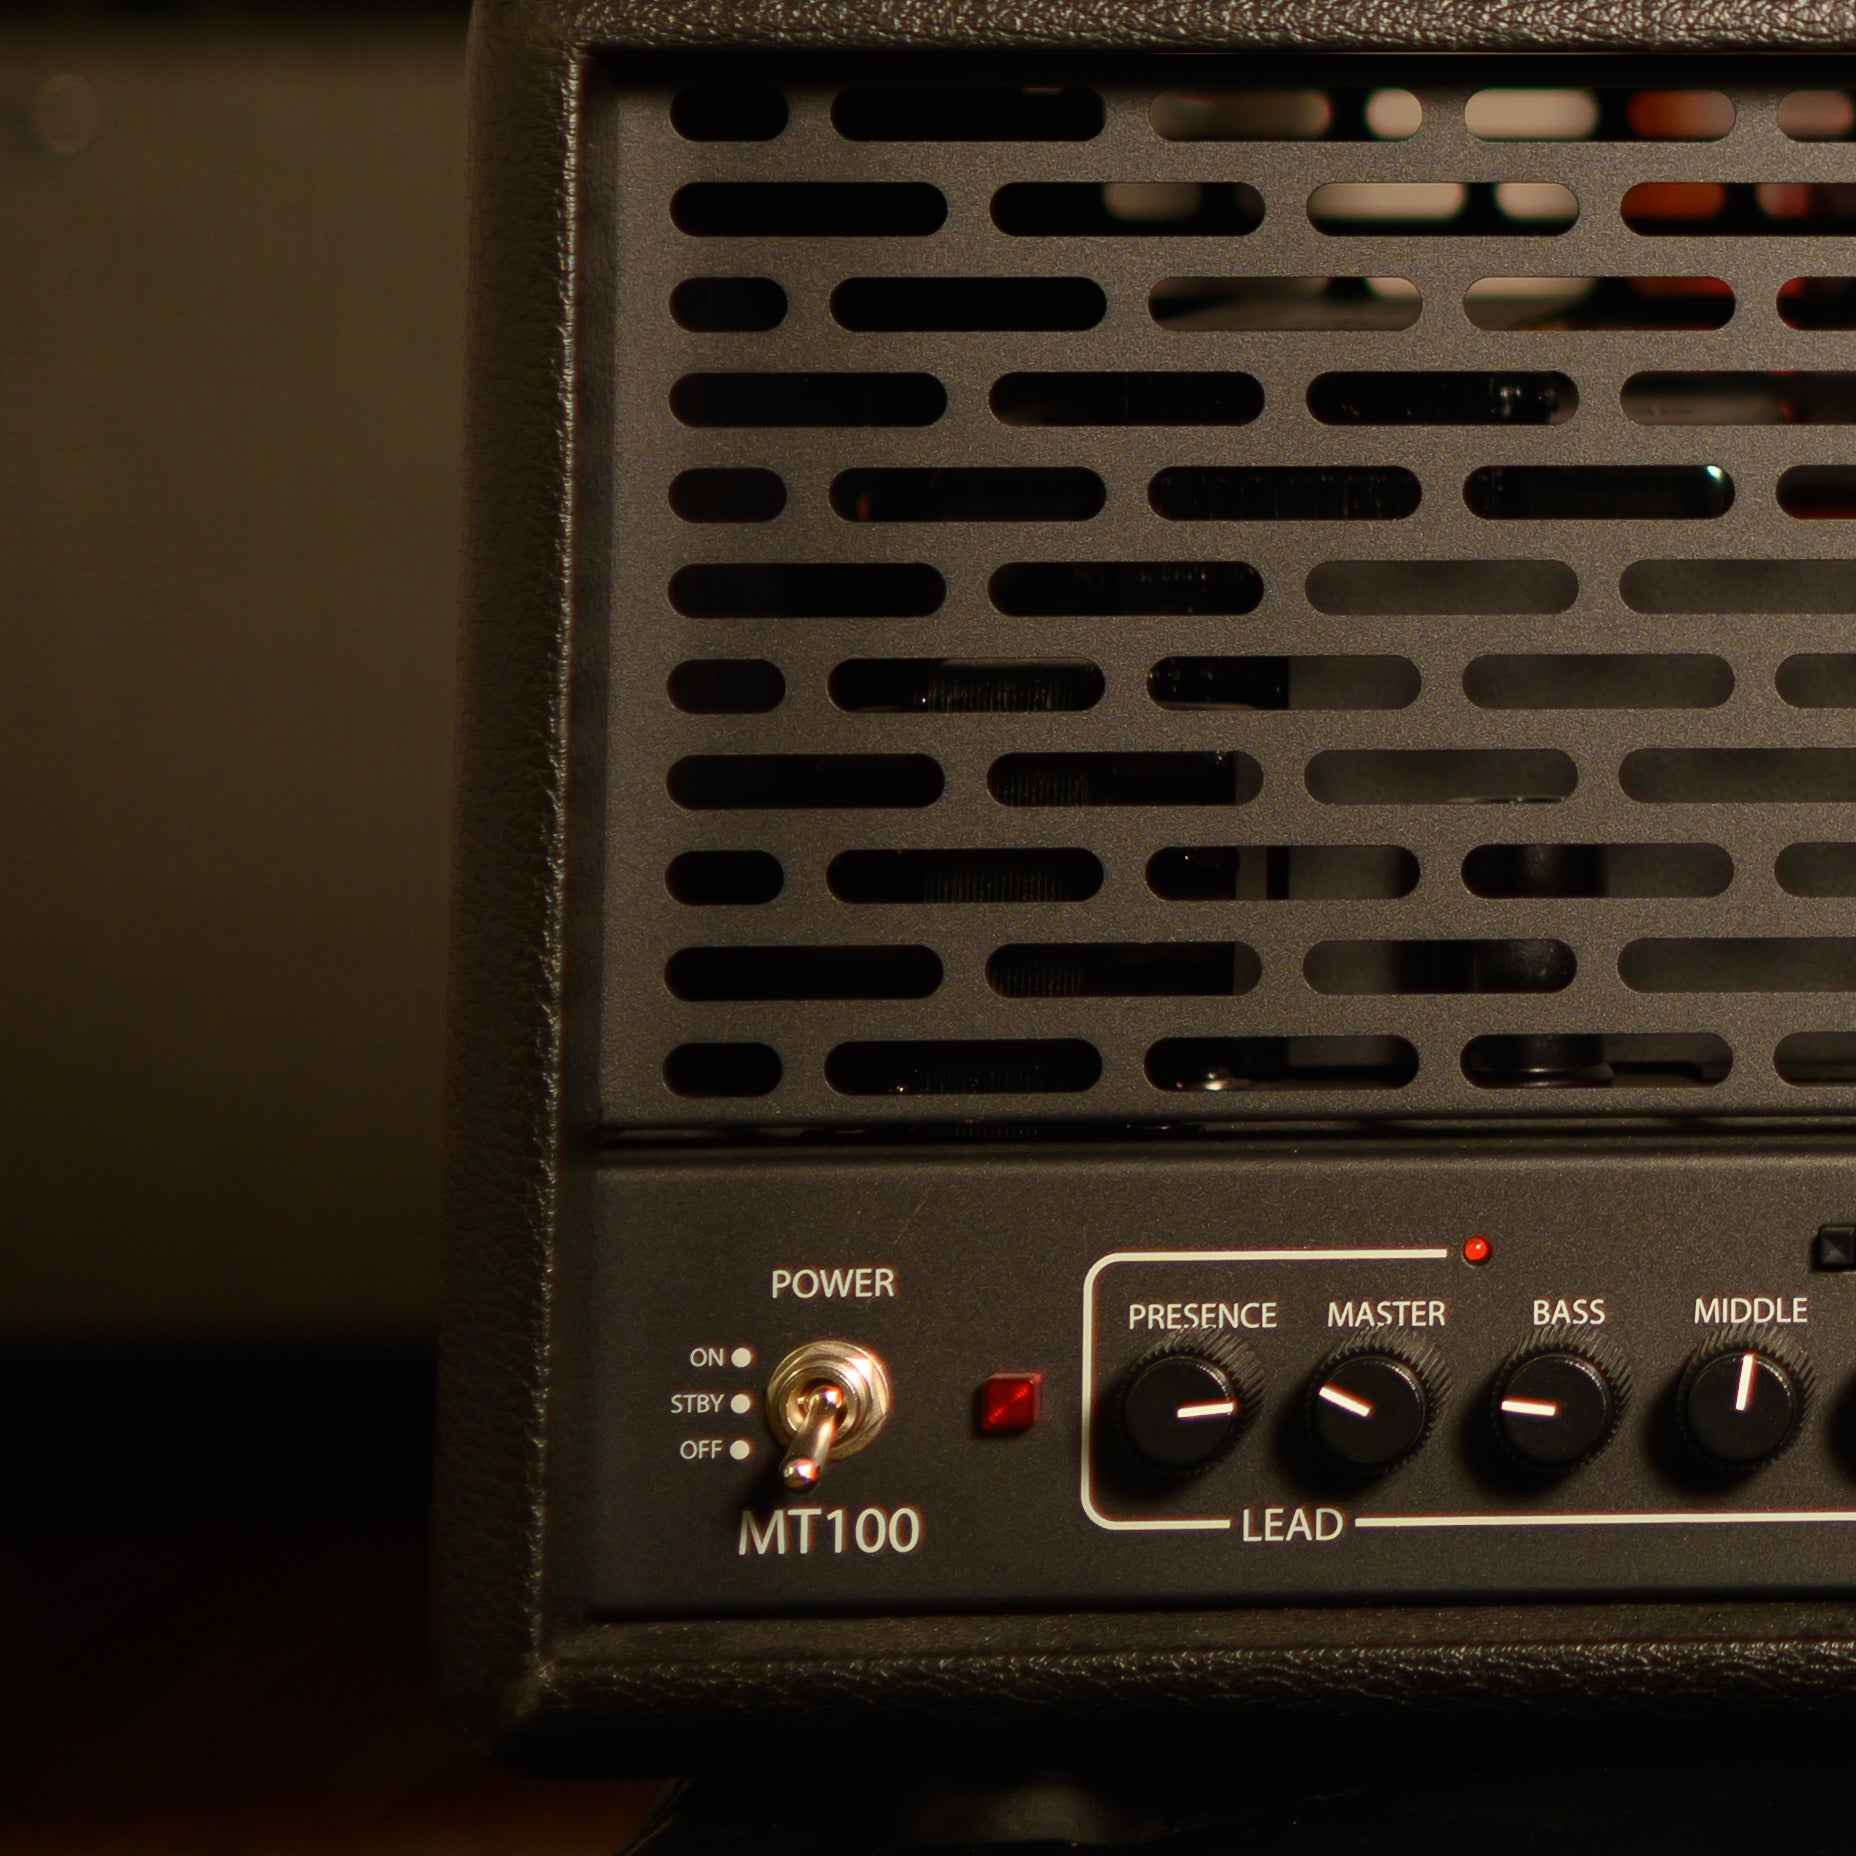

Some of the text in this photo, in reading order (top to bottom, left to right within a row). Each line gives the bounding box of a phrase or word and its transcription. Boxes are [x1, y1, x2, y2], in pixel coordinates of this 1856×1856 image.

[771, 1267, 895, 1300] POWER
[1128, 1301, 1278, 1331] PRESENCE
[1326, 1299, 1447, 1329] MASTER
[1532, 1297, 1607, 1327] BASS
[1693, 1296, 1809, 1325] MIDDLE
[689, 1347, 725, 1368] ON
[670, 1393, 725, 1415] STBY
[679, 1439, 723, 1460] OFF
[738, 1506, 921, 1556] MT100
[1242, 1507, 1344, 1543] LEAD
